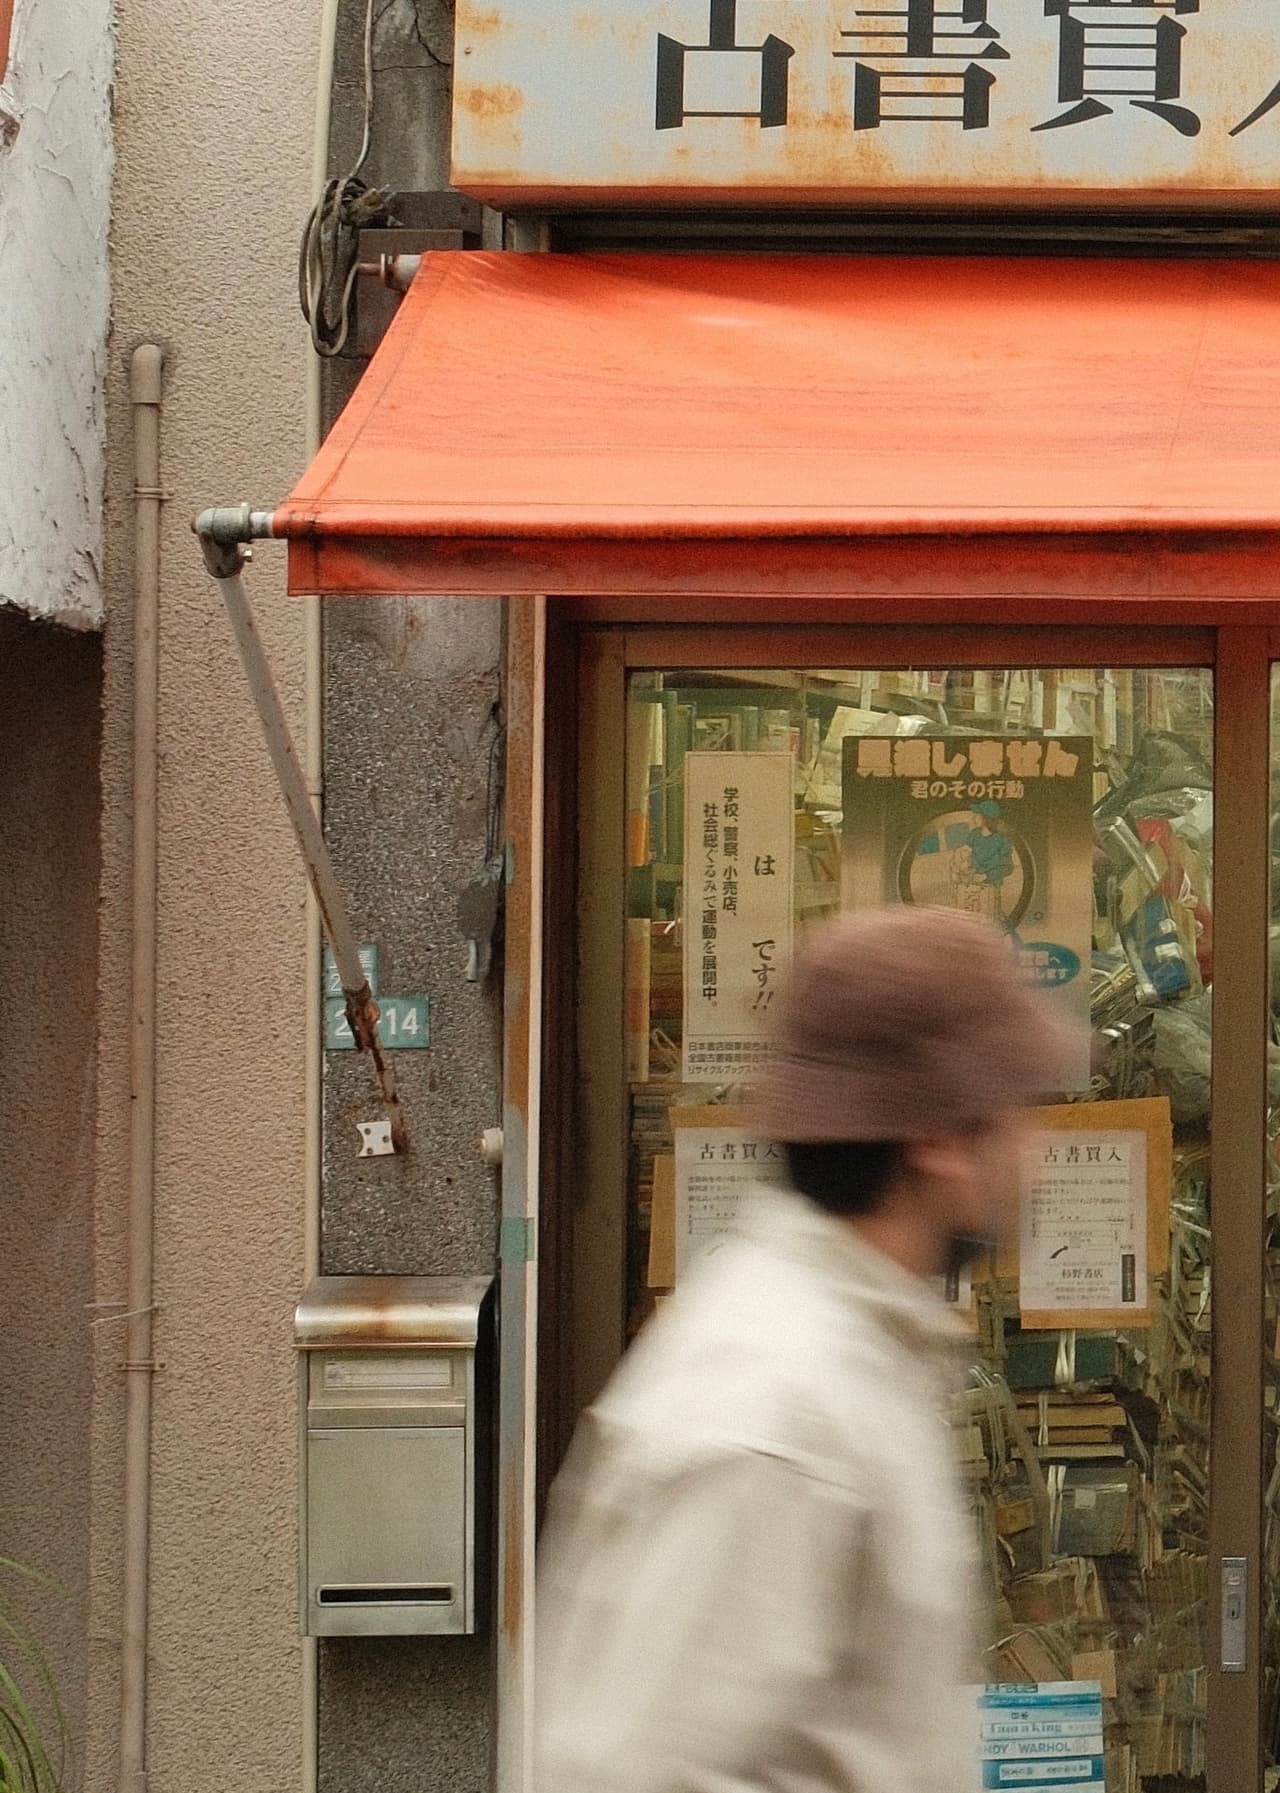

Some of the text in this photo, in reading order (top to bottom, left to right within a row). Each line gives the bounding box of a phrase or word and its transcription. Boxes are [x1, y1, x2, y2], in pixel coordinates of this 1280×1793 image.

[911, 780, 1025, 800] 君のその行動
[754, 854, 776, 877] は
[702, 802, 719, 1007] 社会総ぐるみで運動を展開中。
[1040, 1145, 1123, 1163] 古書買入
[1018, 1741, 1072, 1754] WARHOL
